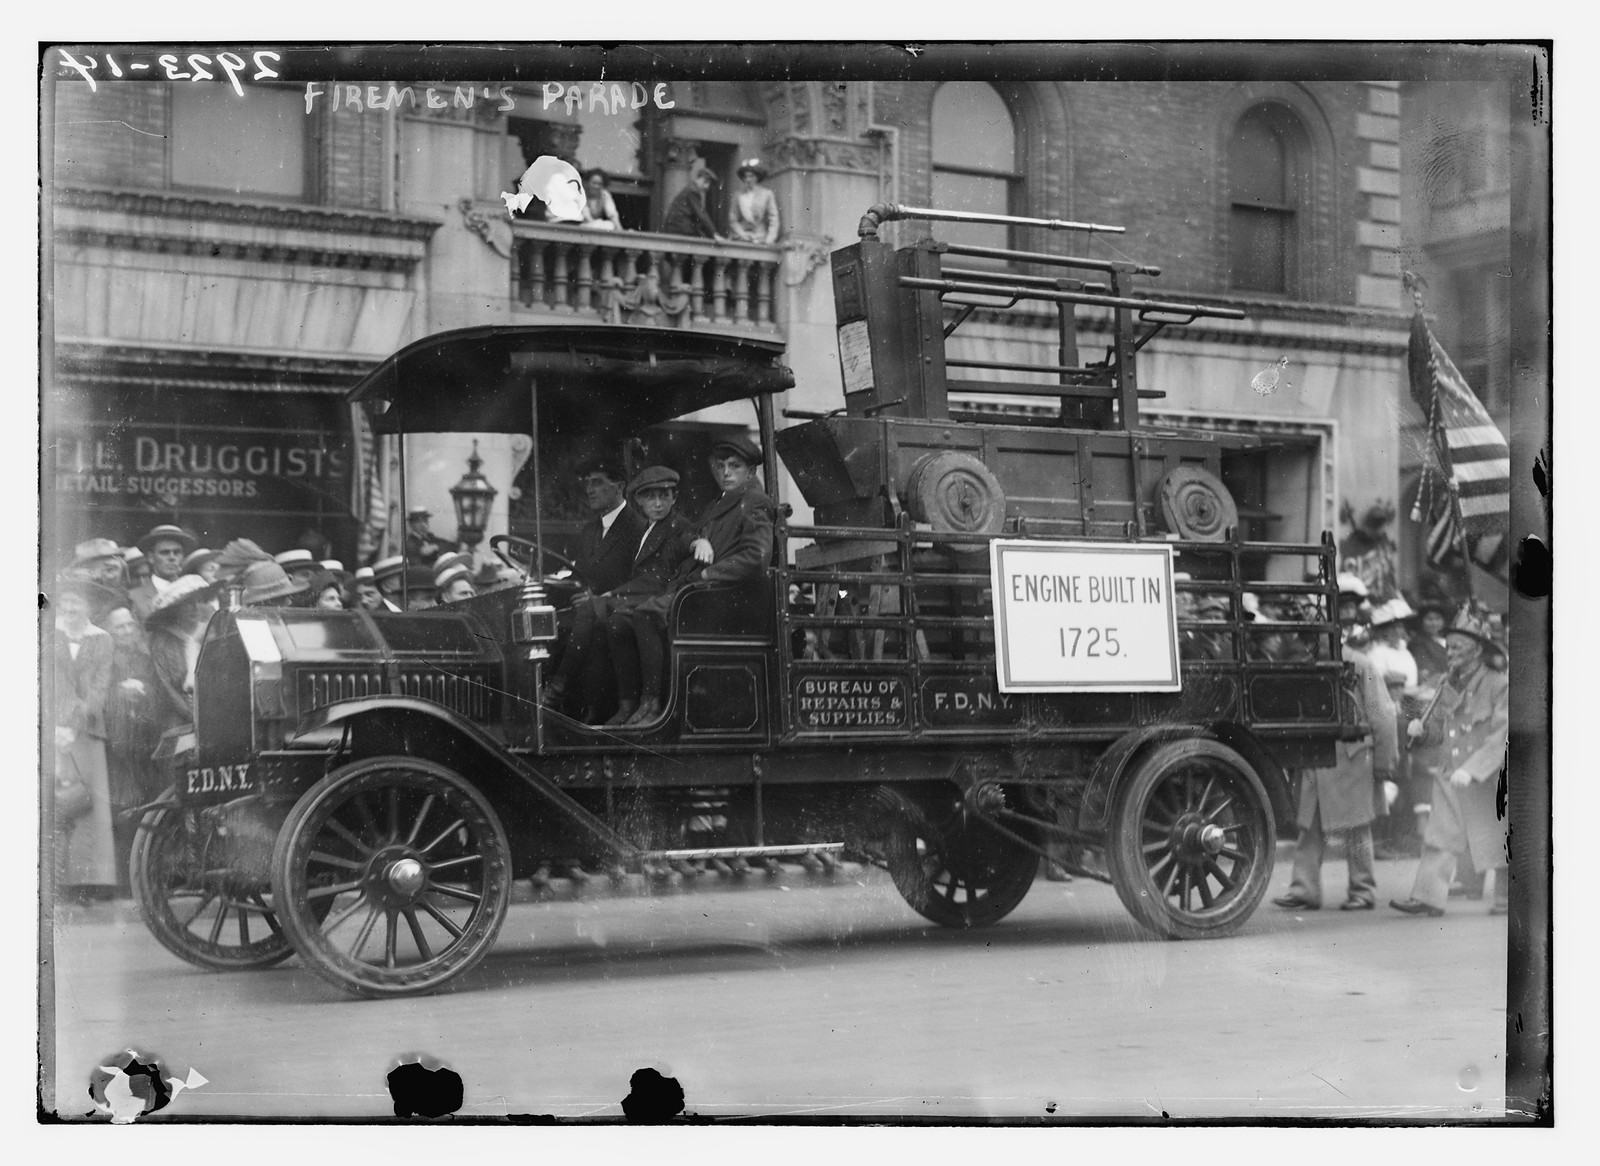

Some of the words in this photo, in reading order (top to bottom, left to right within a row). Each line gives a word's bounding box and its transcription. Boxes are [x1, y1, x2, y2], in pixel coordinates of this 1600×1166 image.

[136, 436, 345, 478] DRUGGISTS
[126, 476, 258, 498] SUCCESSORS
[1012, 574, 1082, 603] ENGINE
[1088, 575, 1136, 604] BUILT
[1142, 576, 1161, 604] IN
[1059, 627, 1128, 658] 1725.
[805, 681, 873, 694] BUREAU
[878, 681, 898, 694] OF
[800, 696, 881, 710] REPAIRS
[890, 696, 903, 710] &
[809, 711, 900, 725] SUPPLIES.
